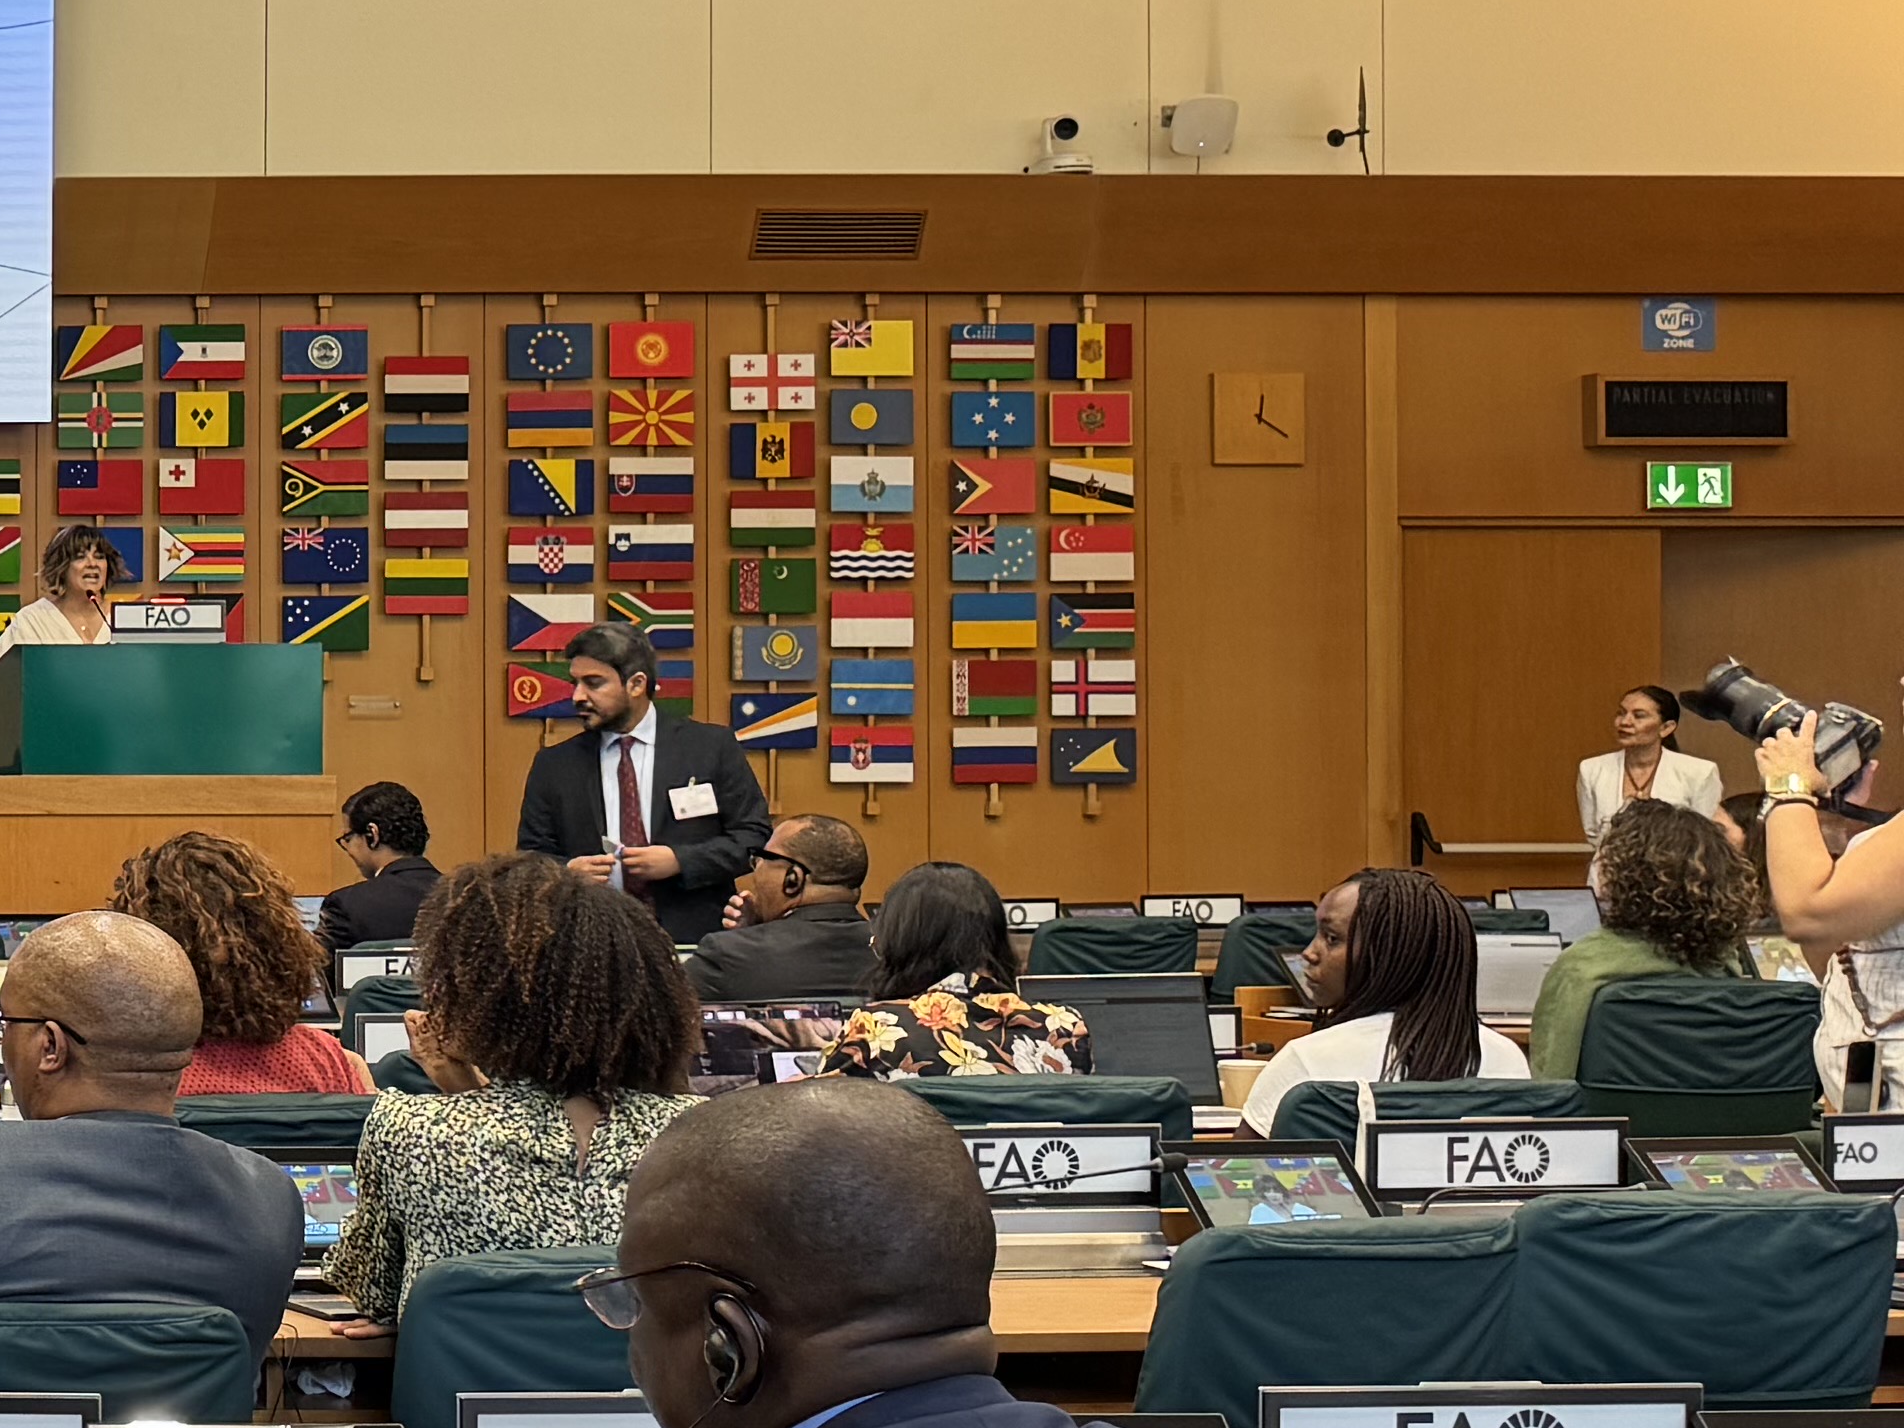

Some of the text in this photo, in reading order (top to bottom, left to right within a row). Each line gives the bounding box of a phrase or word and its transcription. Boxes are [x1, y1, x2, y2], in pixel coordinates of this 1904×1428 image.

[1663, 338, 1695, 349] ZONE
[1613, 387, 1675, 405] PARTIAL
[145, 607, 191, 627] FAO
[1172, 900, 1213, 922] FAO
[1446, 1133, 1551, 1184] FAO
[1833, 1141, 1878, 1164] FAO
[972, 1139, 1080, 1191] FAO
